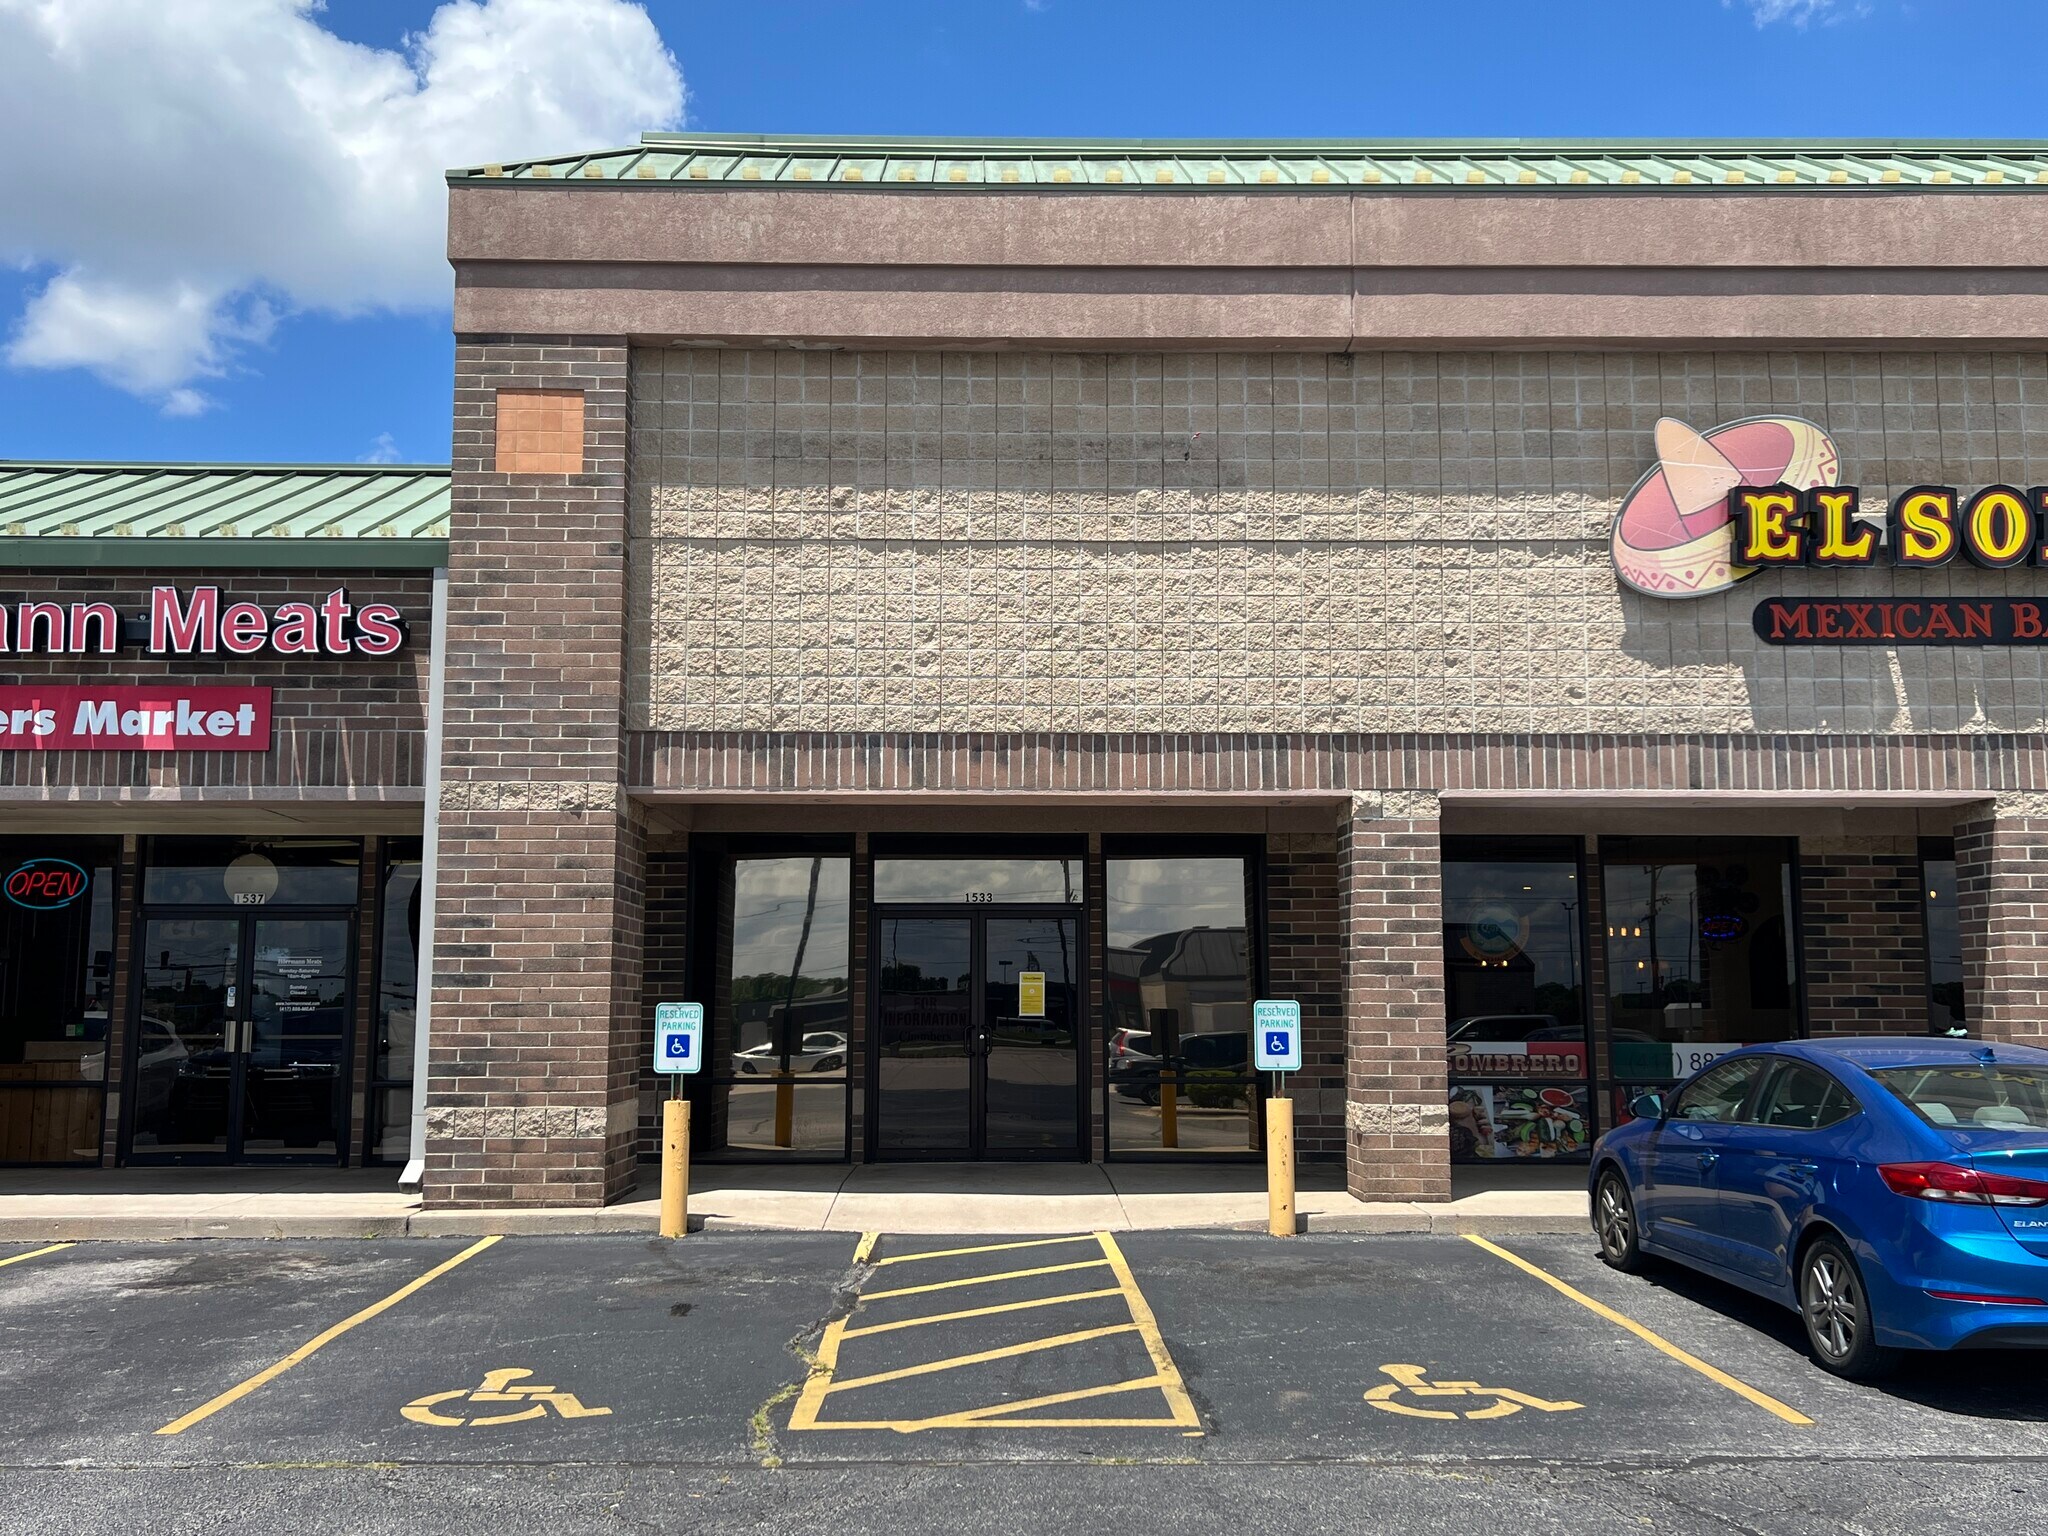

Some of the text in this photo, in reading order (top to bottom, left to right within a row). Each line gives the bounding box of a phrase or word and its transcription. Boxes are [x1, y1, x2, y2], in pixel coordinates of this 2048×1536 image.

[1740, 490, 2048, 562] EL SO
[0, 585, 403, 655] nn Meats
[1768, 602, 2048, 639] MEXICAN B
[0, 700, 256, 736] rs Market
[8, 871, 82, 897] OPEN
[236, 893, 264, 904] 1537
[965, 892, 993, 903] 1533
[1703, 921, 1743, 932] OPEN
[659, 1009, 699, 1019] RESERVED
[1257, 1007, 1297, 1017] RESERVED
[884, 1012, 967, 1026] INFORMATION
[1260, 1019, 1295, 1028] PARKING
[661, 1021, 697, 1031] PARKING
[1690, 1052, 1727, 1071] 88
[2013, 1220, 2048, 1228] ELAN
